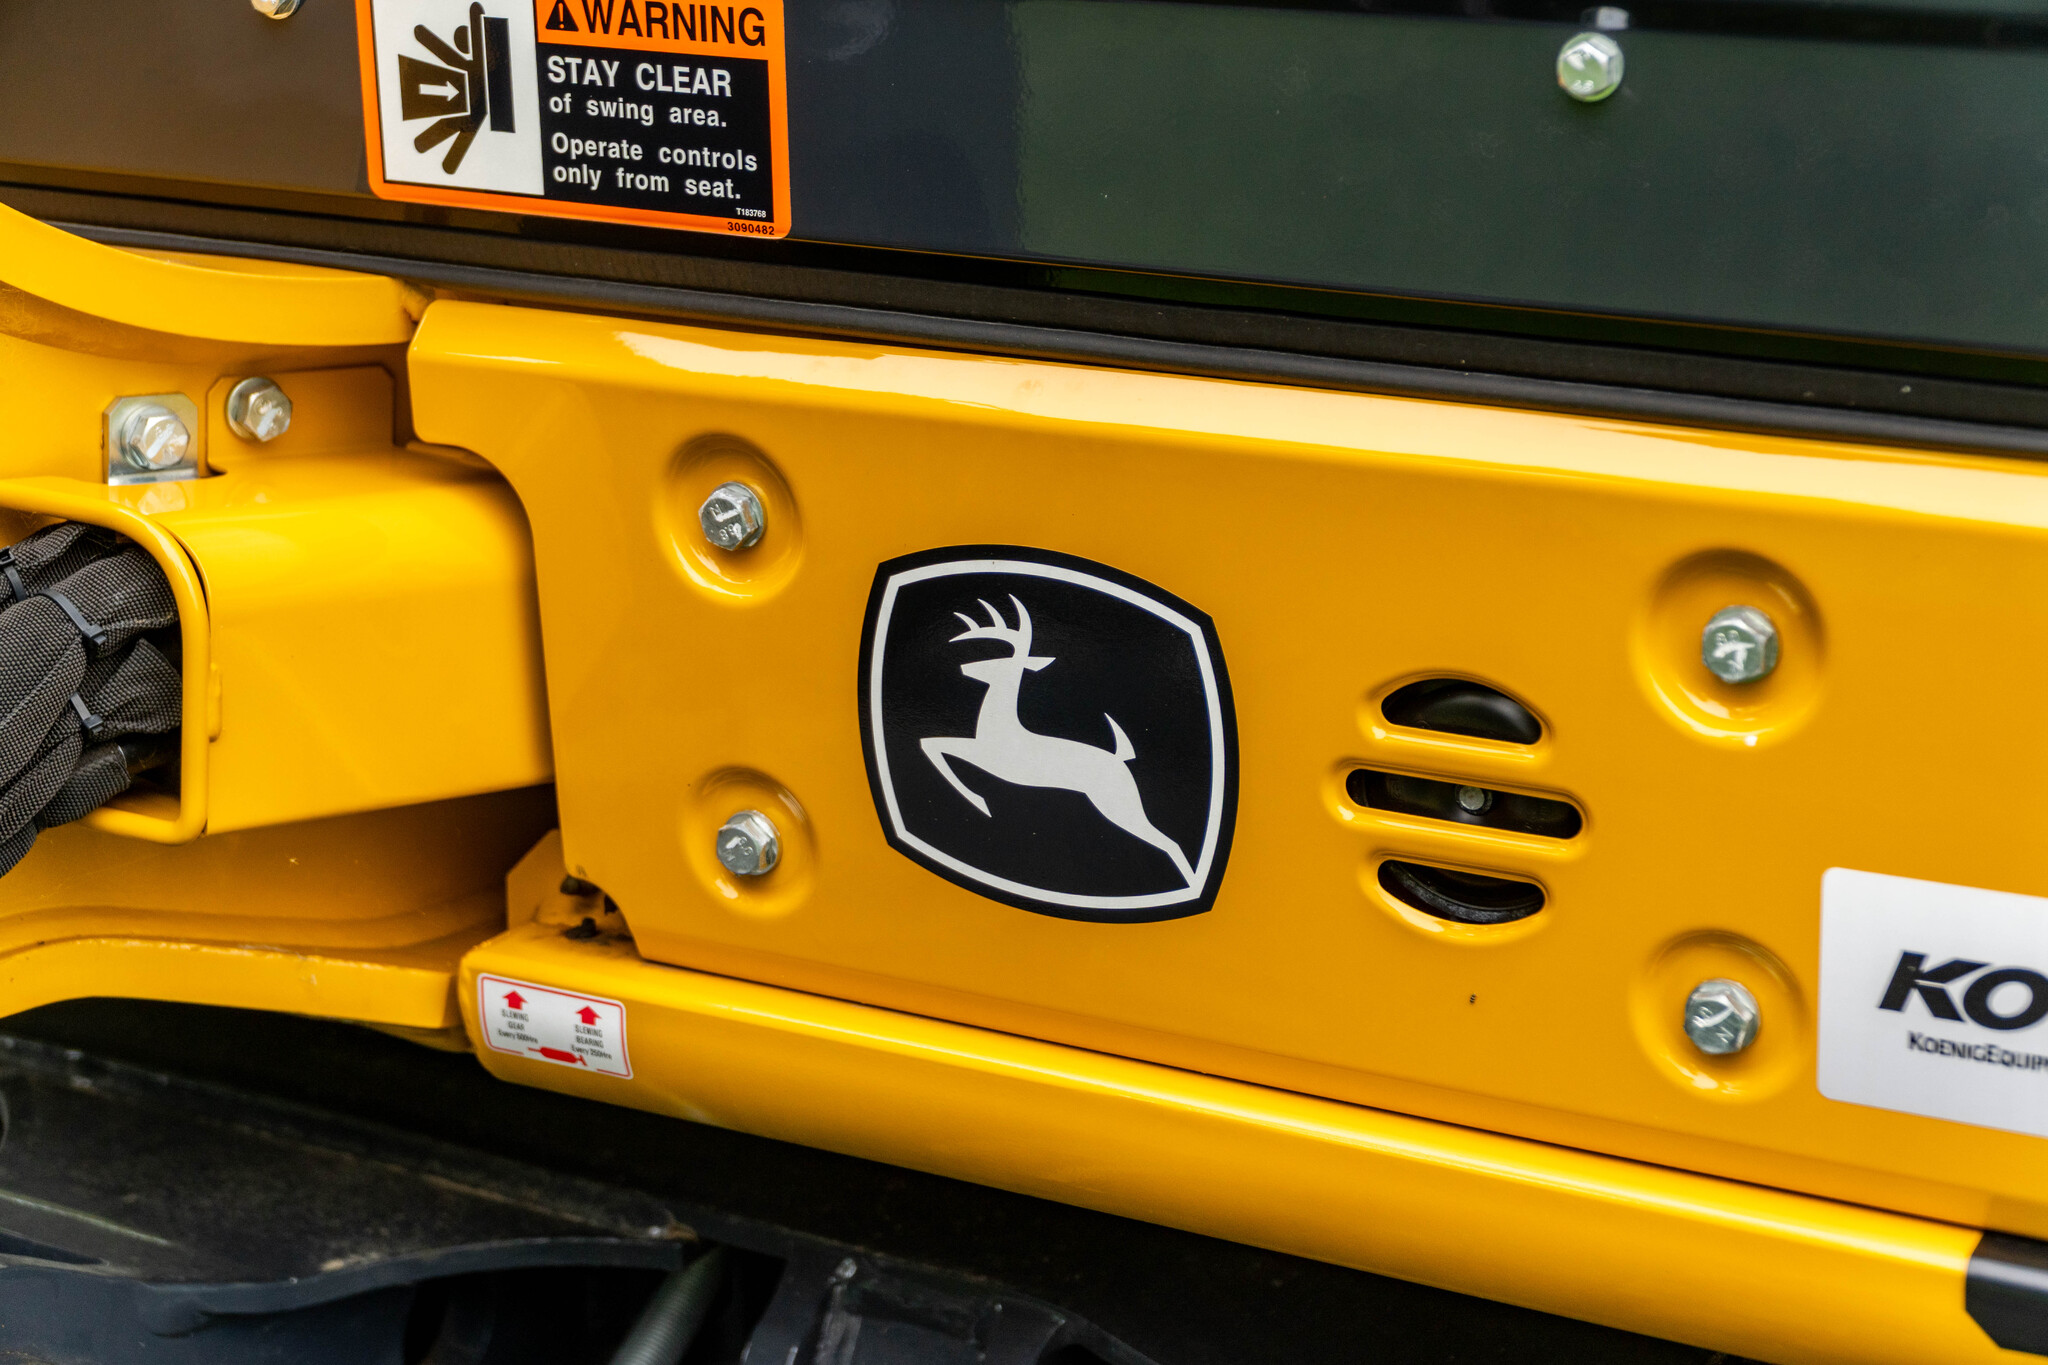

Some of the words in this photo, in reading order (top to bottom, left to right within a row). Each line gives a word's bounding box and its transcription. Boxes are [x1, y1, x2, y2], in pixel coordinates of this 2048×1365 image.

[582, 0, 767, 47] WARNING
[547, 55, 620, 88] STAY
[635, 62, 732, 98] CLEAR
[549, 93, 572, 114] of
[586, 95, 654, 126] swing
[669, 106, 728, 128] area.
[551, 132, 643, 161] Operate
[658, 143, 758, 172] controls
[553, 163, 601, 191] only
[616, 167, 670, 193] from
[684, 176, 742, 200] seat.
[727, 221, 775, 236] 3090482
[735, 207, 767, 218] T183768
[575, 1024, 603, 1038] SLEWING
[576, 1035, 604, 1048] BEARING
